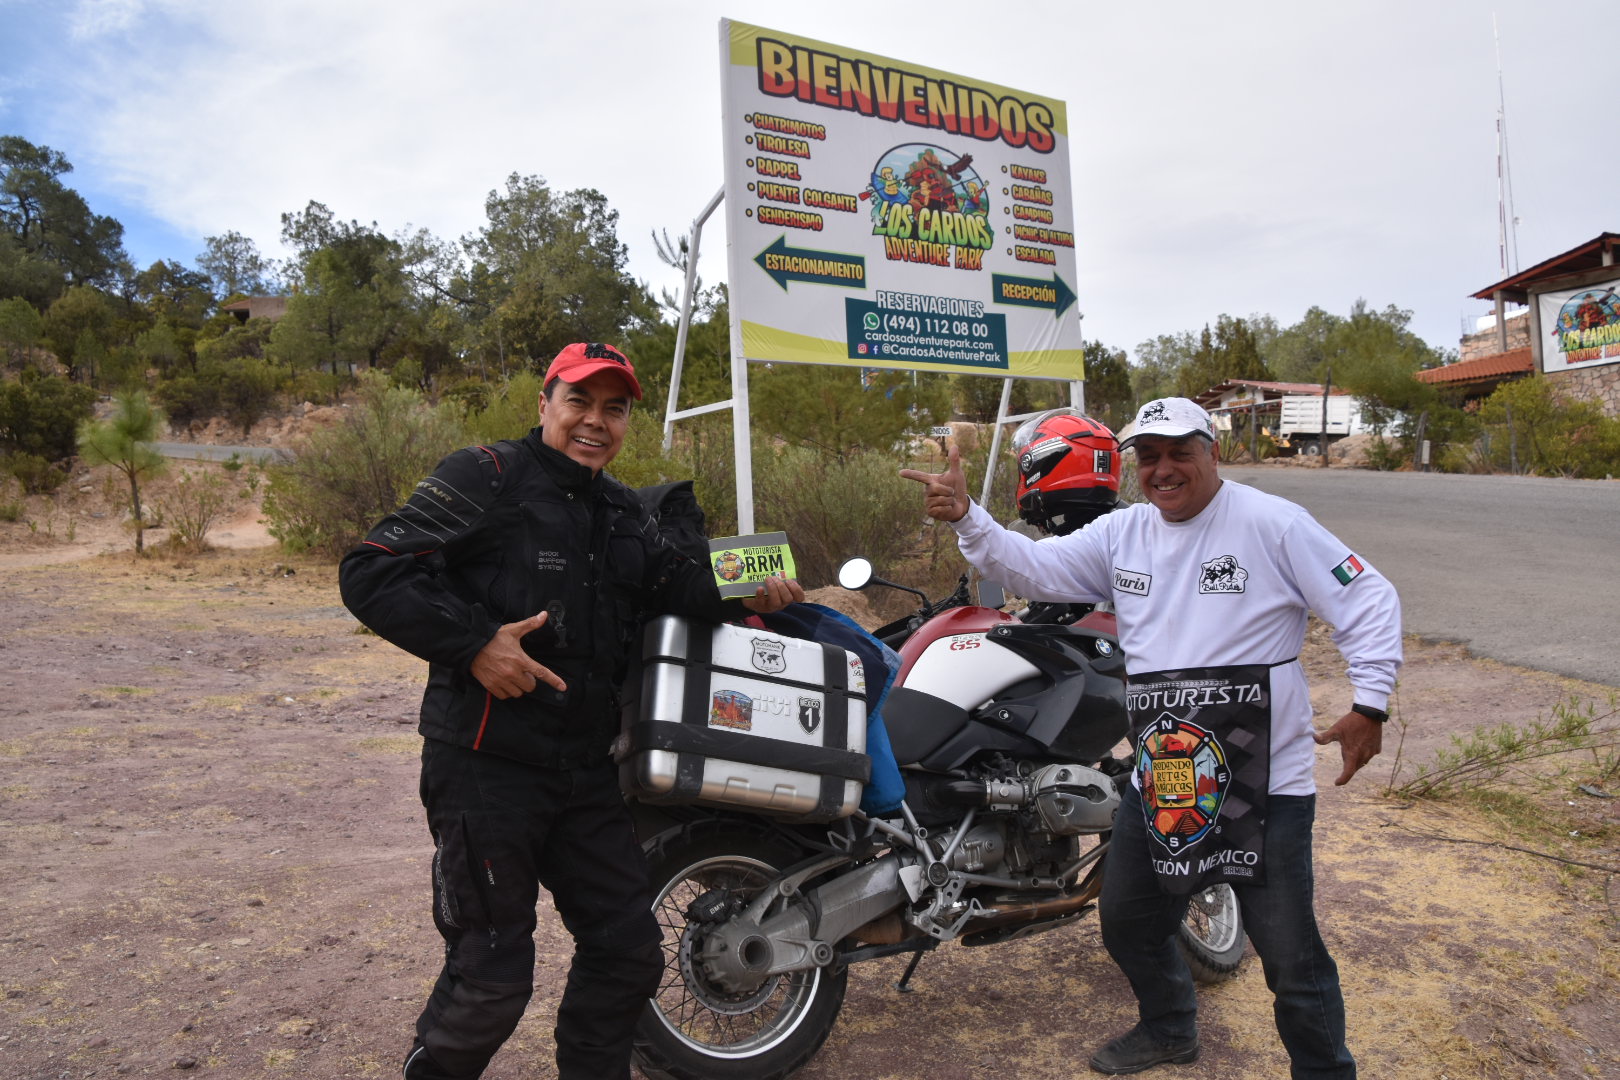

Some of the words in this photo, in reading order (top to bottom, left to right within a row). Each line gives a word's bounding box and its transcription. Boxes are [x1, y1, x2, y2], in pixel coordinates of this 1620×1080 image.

[756, 37, 1055, 153] BIENVENIDOS
[753, 112, 826, 141] CUATRIMOTOS
[754, 132, 811, 159] TIROLESA
[756, 157, 801, 181] RAPPEL
[1010, 164, 1047, 184] KAYAKS
[757, 181, 800, 204] PUENTE
[803, 188, 857, 213] COLGANTE
[1011, 184, 1053, 206] CABAÑAS
[757, 205, 823, 231] SENDERISMO
[1012, 204, 1053, 224] CAMPING
[872, 201, 913, 238] LOS
[918, 207, 993, 250] CARDOS
[1013, 224, 1039, 242] PICNIC
[1039, 228, 1049, 244] EN
[1049, 229, 1075, 248] ALTURA
[884, 236, 950, 267] ADVENTURE
[955, 246, 984, 271] PARK
[1015, 245, 1056, 266] ESCALADA
[765, 253, 863, 280] ESTACIONAMIENTO
[1002, 283, 1056, 303] RECEPCIÓN
[876, 290, 984, 318] RESERVACIONES
[883, 314, 921, 334] (494)
[925, 318, 949, 334] 112
[953, 321, 969, 336] 08
[972, 323, 988, 337] 00
[865, 331, 994, 350] cardosadventurepark.com
[882, 343, 1001, 363] @CardosAdventurePark
[743, 546, 782, 556] MOTOTURISTA
[745, 554, 785, 573] RRM
[1115, 573, 1145, 591] Paris
[950, 639, 980, 651] GS
[1127, 683, 1262, 711] OTOTURISTA
[805, 708, 812, 727] 1
[1161, 720, 1172, 730] N
[1218, 773, 1227, 783] E
[1170, 837, 1179, 847] S
[1197, 849, 1258, 874] MÉXICO
[709, 901, 725, 915] BMW
